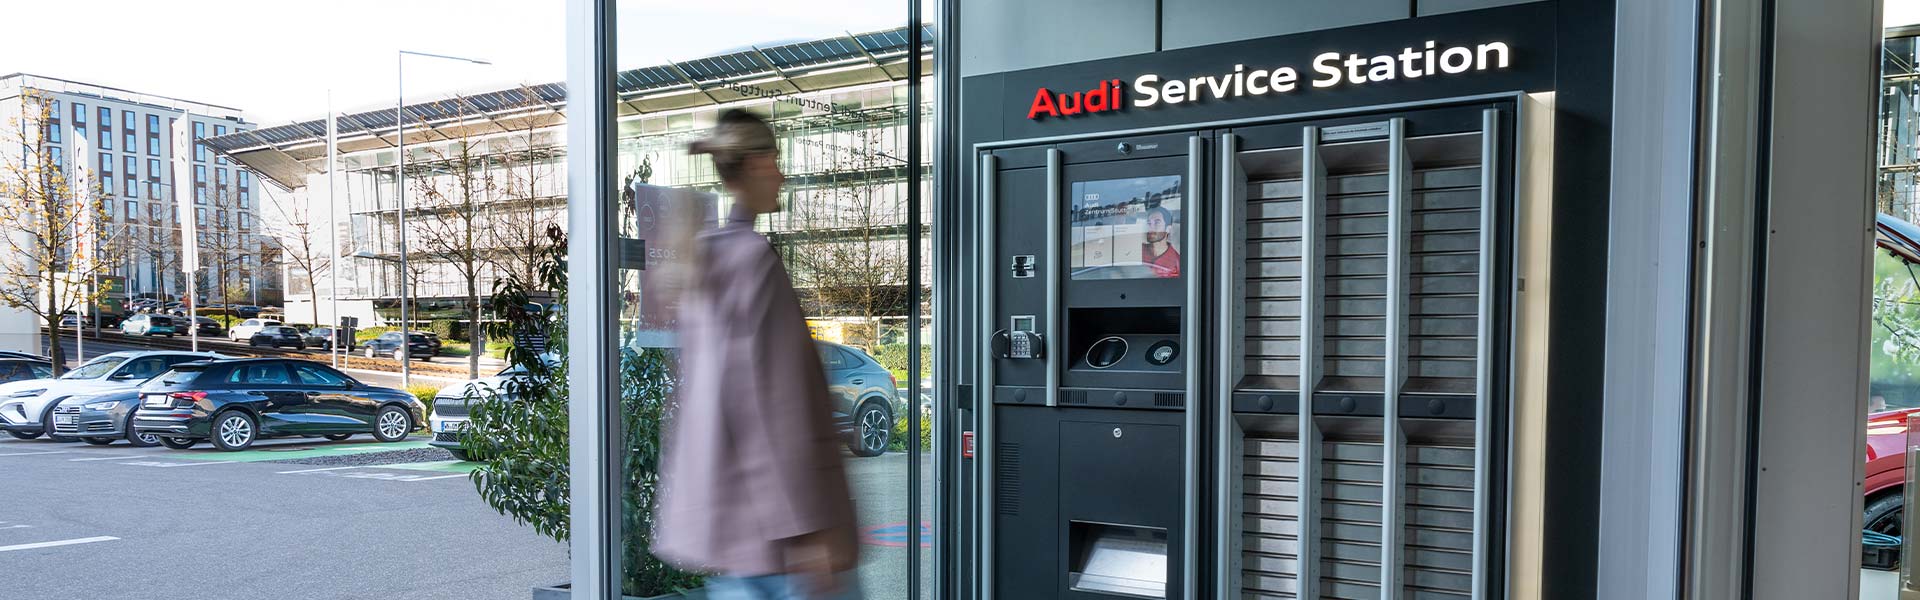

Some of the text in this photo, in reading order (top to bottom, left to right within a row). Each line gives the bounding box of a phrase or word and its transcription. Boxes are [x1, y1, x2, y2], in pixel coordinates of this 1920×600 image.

[1028, 40, 1509, 118] Audi Service Station
